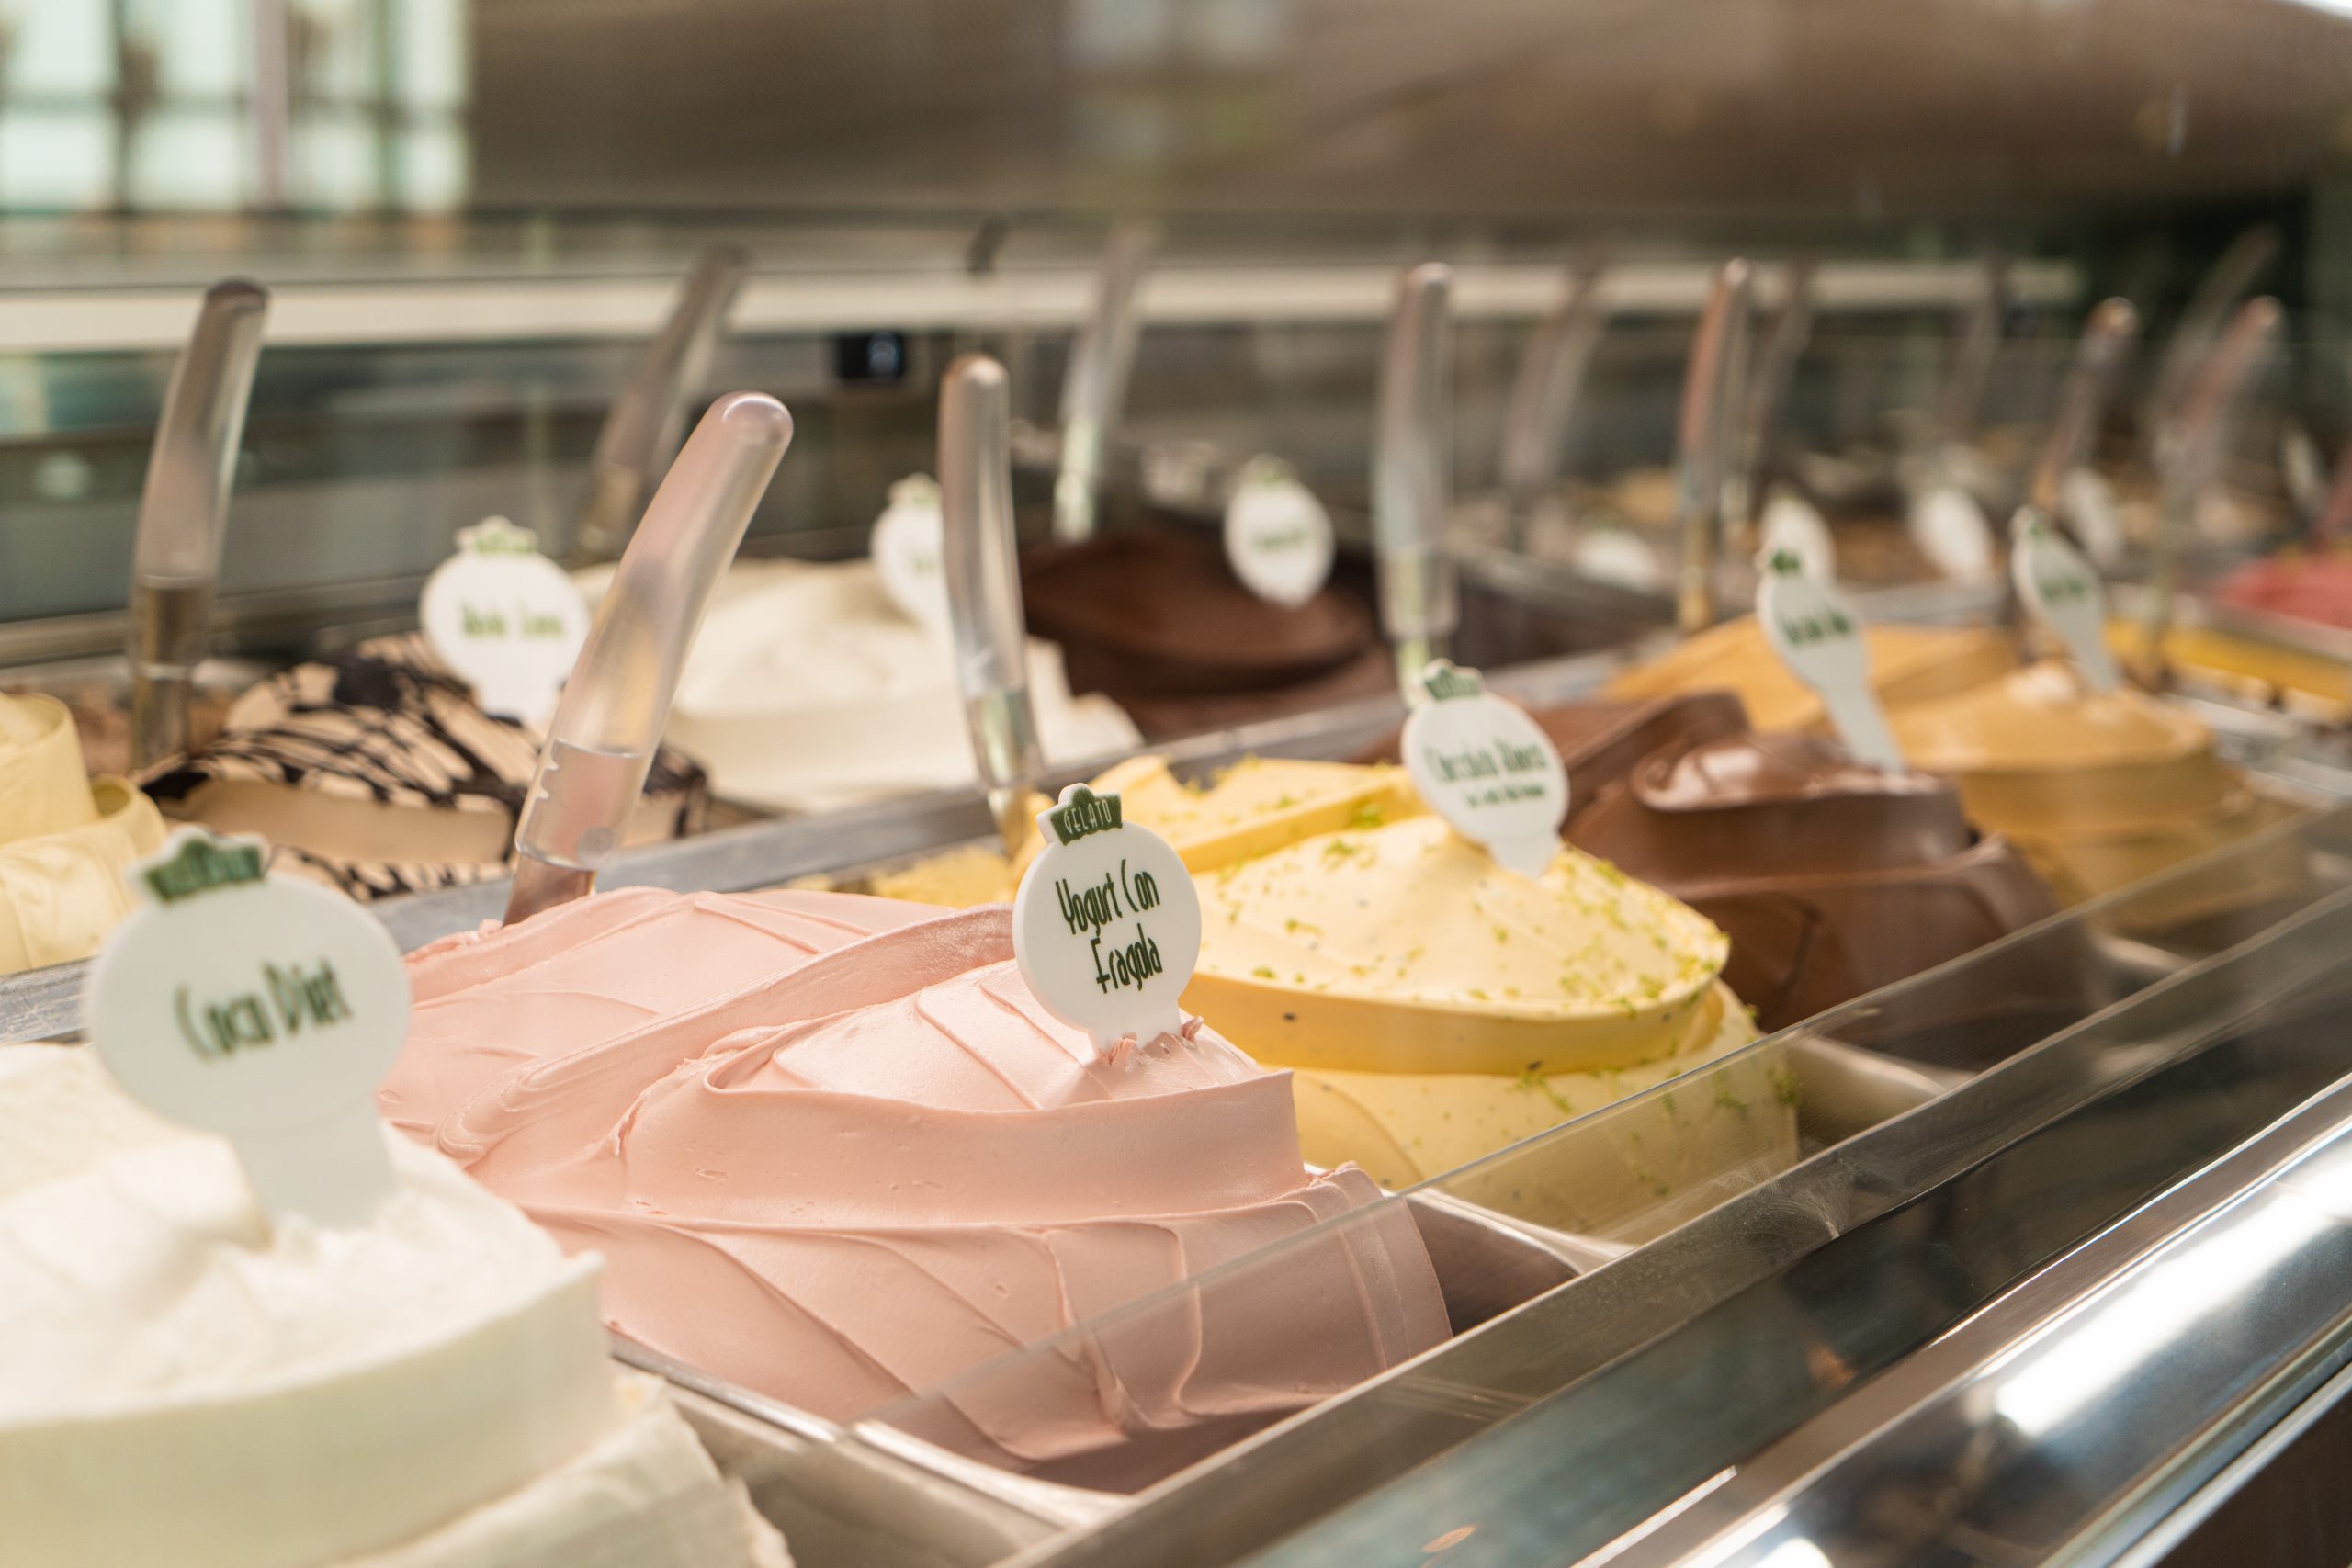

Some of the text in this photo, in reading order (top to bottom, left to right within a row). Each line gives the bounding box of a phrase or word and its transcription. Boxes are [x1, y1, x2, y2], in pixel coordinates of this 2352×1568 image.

[1063, 798, 1112, 835] GELATO
[1055, 858, 1161, 938] Yogurt Con
[1090, 922, 1163, 995] Fragola
